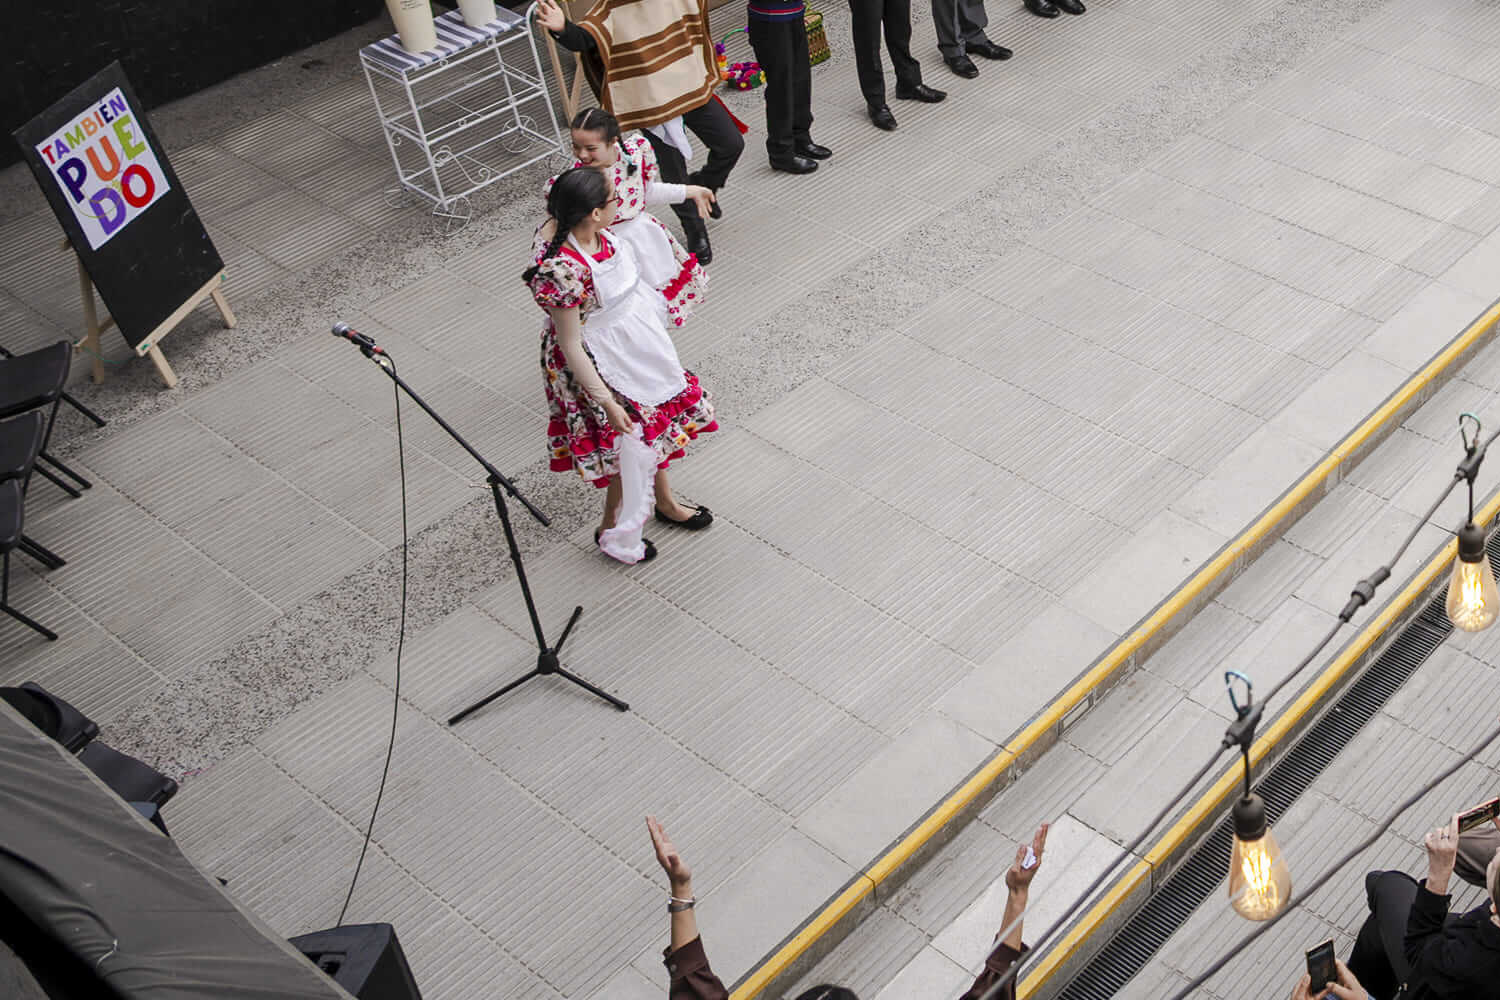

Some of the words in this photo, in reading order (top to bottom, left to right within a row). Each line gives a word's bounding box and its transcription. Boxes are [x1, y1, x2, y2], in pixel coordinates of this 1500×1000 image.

[41, 94, 127, 165] TAMBIÉN
[57, 114, 146, 204] PUE
[89, 163, 156, 236] DO
